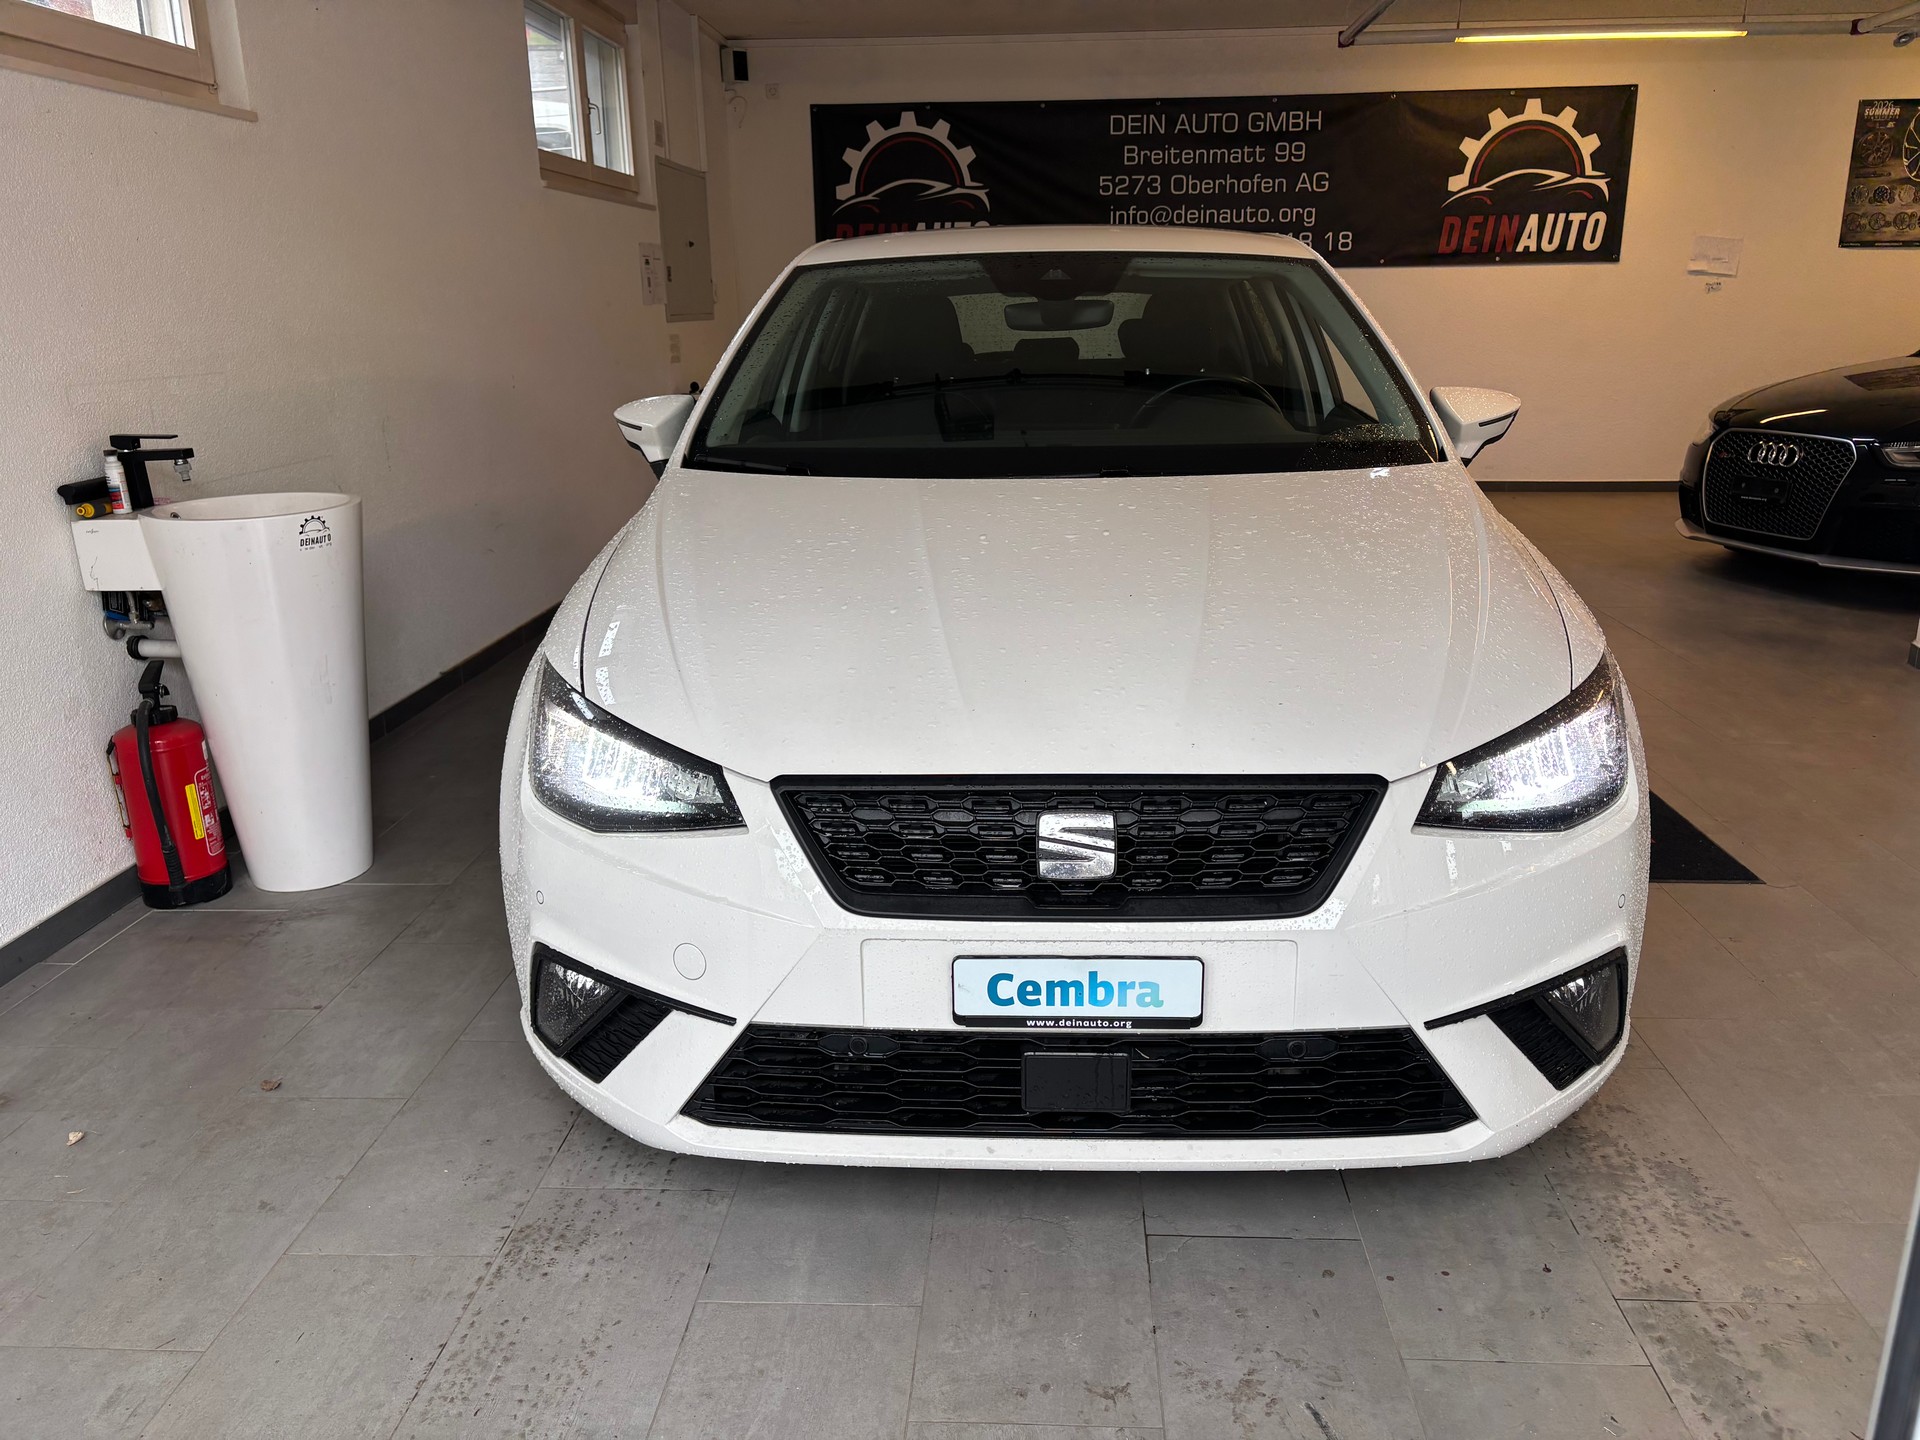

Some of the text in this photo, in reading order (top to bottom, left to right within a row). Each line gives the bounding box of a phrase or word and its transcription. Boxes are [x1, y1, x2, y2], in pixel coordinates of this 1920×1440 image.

[1110, 110, 1322, 135] DEIN AUTO GMBH
[1124, 141, 1306, 166] Breitenmatt 99
[1099, 171, 1330, 196] 5273 Oberhofen AG
[1110, 204, 1316, 227] info@deinauto.org
[1324, 231, 1353, 251] 18
[1438, 211, 1607, 254] DEINAUTO
[987, 970, 1164, 1008] Cembra
[1026, 1018, 1132, 1029] www.deinauto.org
